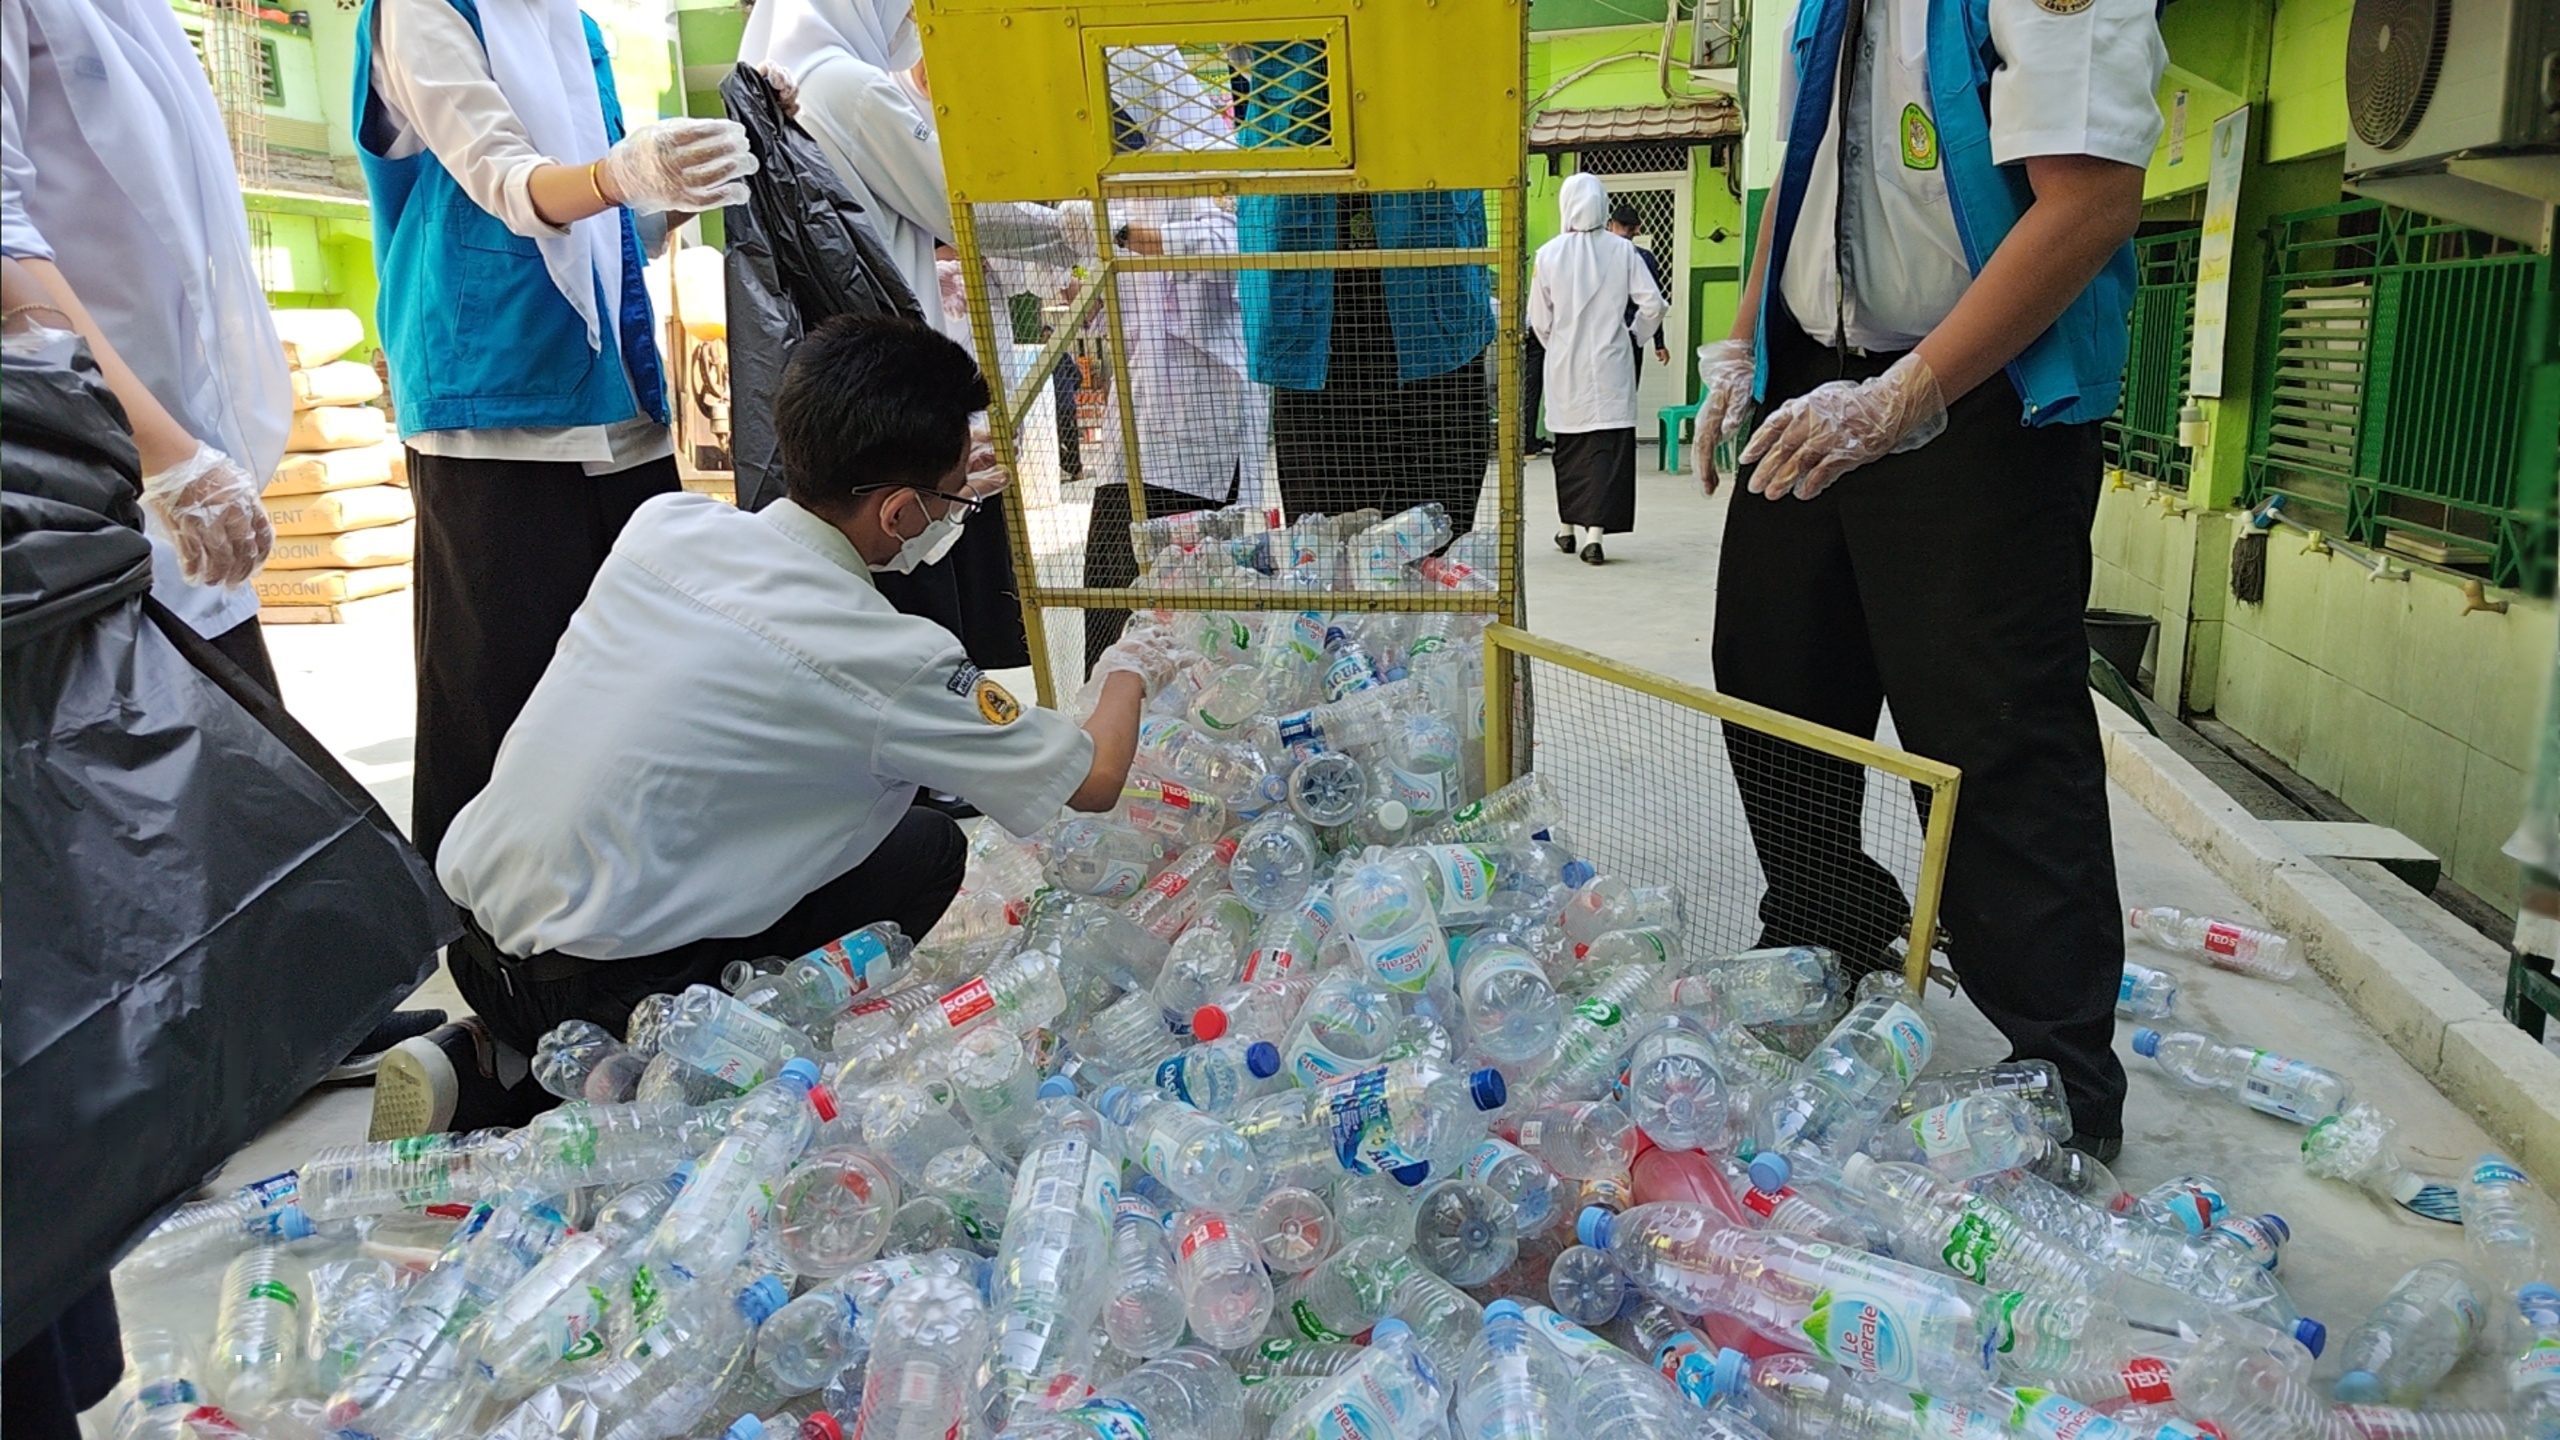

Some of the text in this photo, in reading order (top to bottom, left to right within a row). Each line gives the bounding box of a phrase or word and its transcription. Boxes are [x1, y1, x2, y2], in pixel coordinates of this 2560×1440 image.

[268, 509, 304, 525] ENT
[267, 543, 320, 560] INDOC
[257, 582, 321, 597] INDOCE
[1376, 933, 1433, 971] Minerale
[1839, 1331, 1858, 1354] Le
[2046, 1406, 2073, 1423] Le
